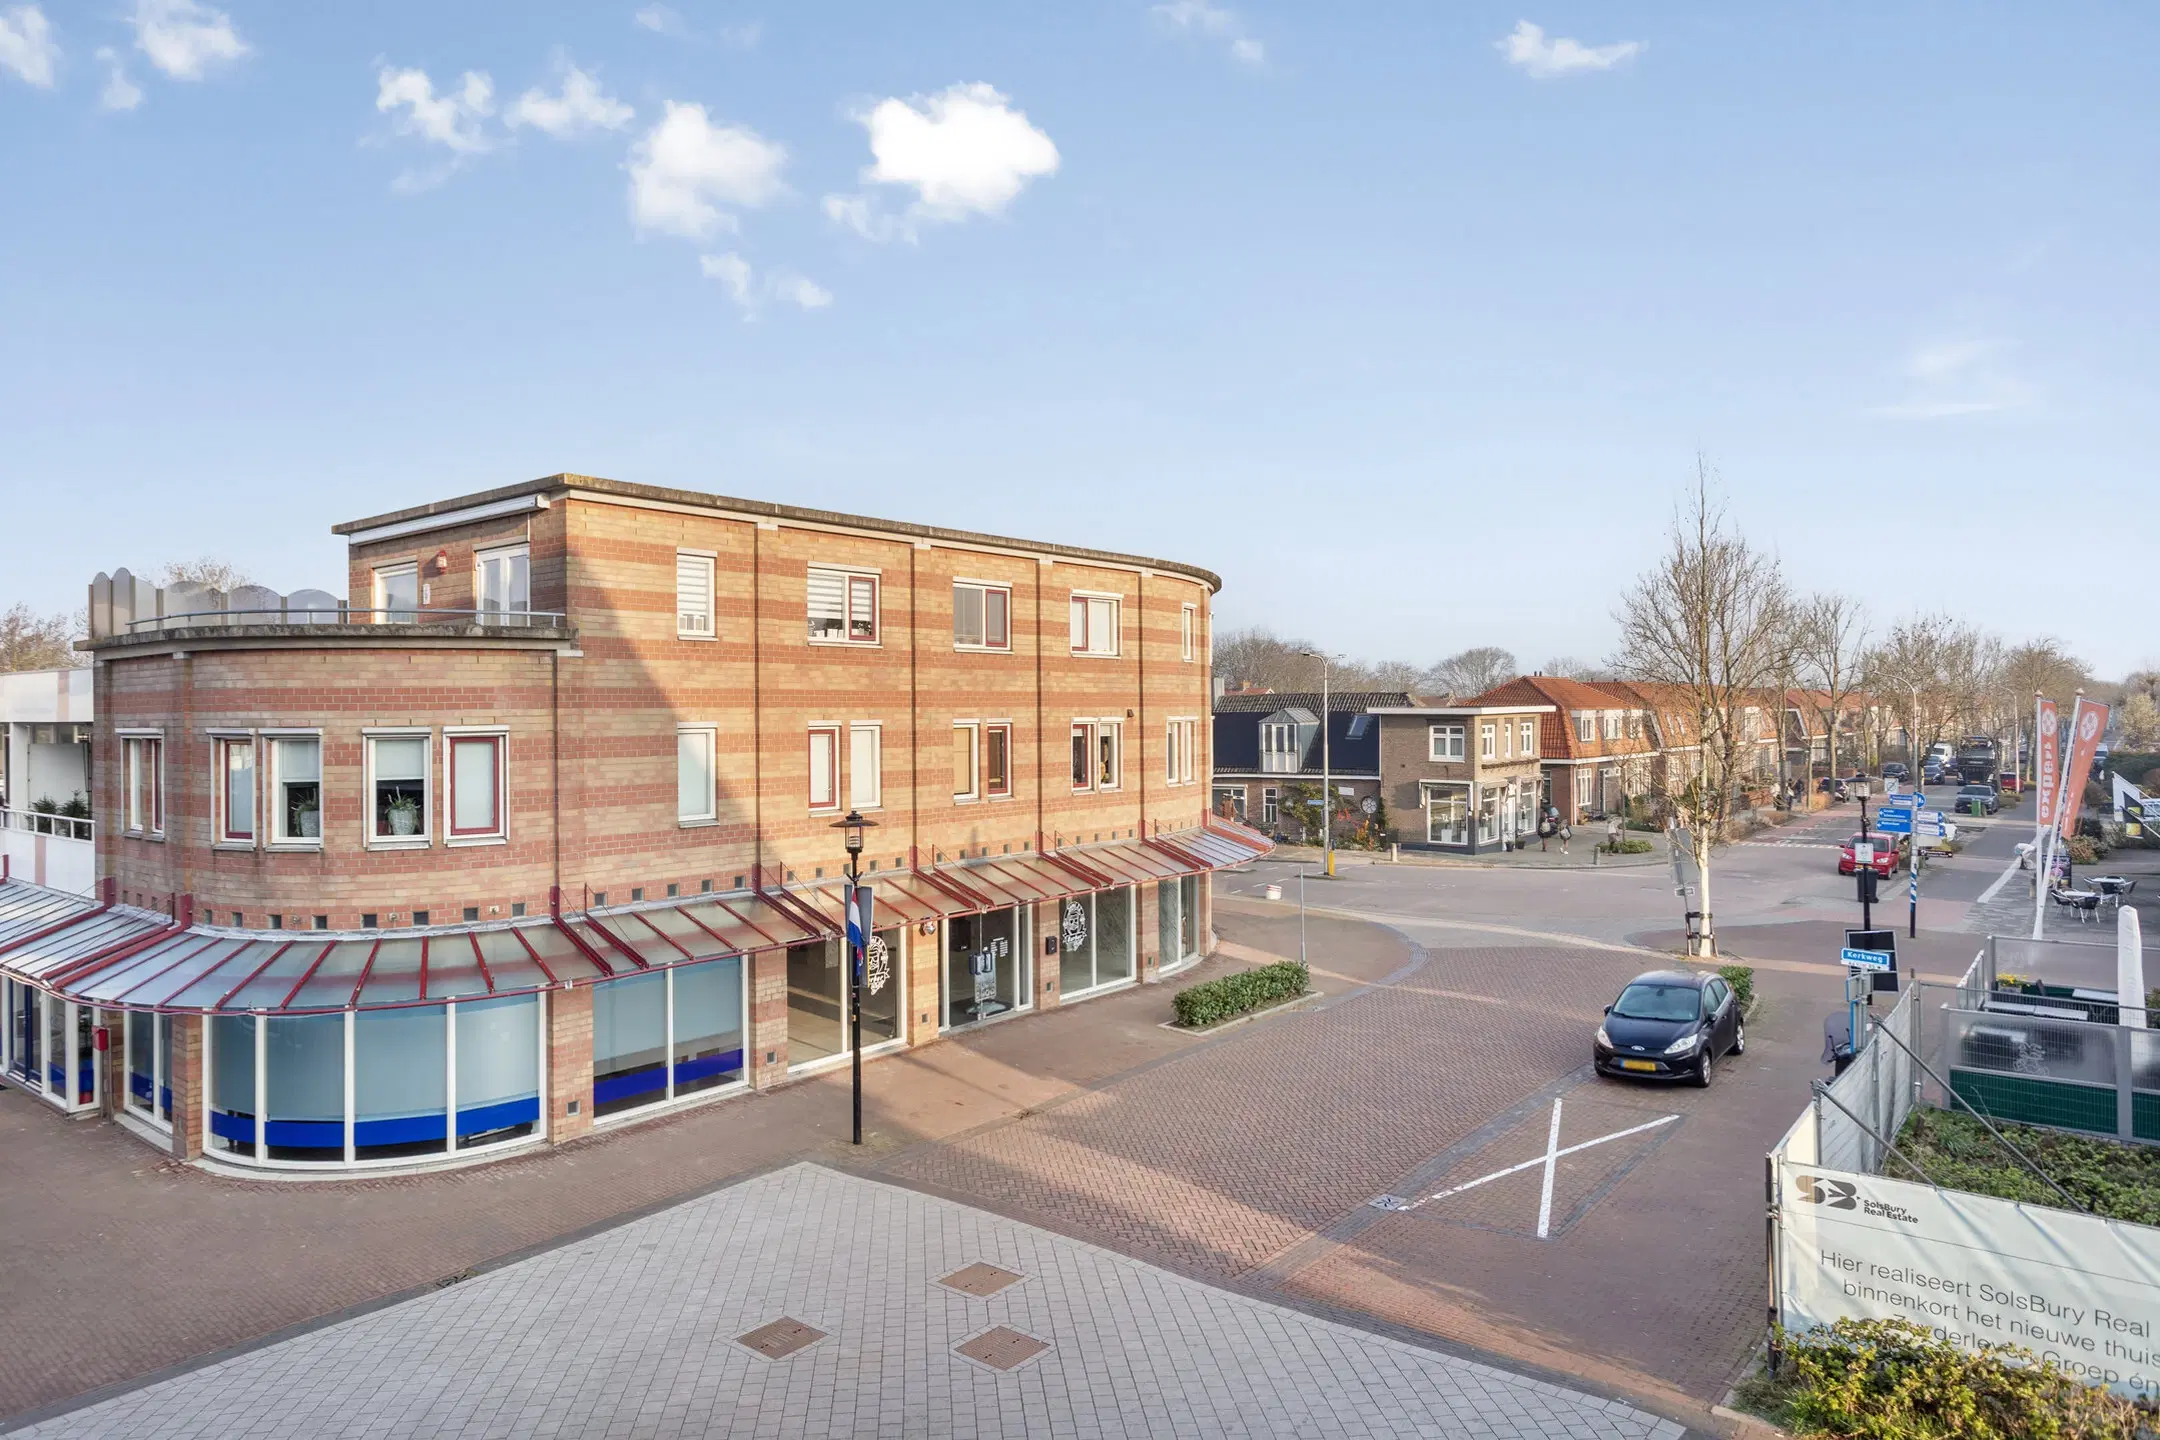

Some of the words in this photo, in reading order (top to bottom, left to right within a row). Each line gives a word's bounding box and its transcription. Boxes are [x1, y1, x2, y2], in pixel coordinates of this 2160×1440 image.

[2041, 742, 2055, 818] expert
[1847, 951, 1883, 964] Kerkweg
[1864, 1199, 1907, 1215] SolsBury
[1864, 1207, 1885, 1217] Real
[1886, 1212, 1920, 1224] Estate
[1821, 1250, 1863, 1273] Hier
[1871, 1263, 1972, 1298] realiseert
[1979, 1283, 2085, 1326] SolsBury
[2095, 1309, 2150, 1338] Real
[1843, 1279, 1959, 1320] binnenkort
[1966, 1306, 2003, 1331] het
[2010, 1319, 2096, 1352] nieuwe
[2042, 1350, 2120, 1384] Groep
